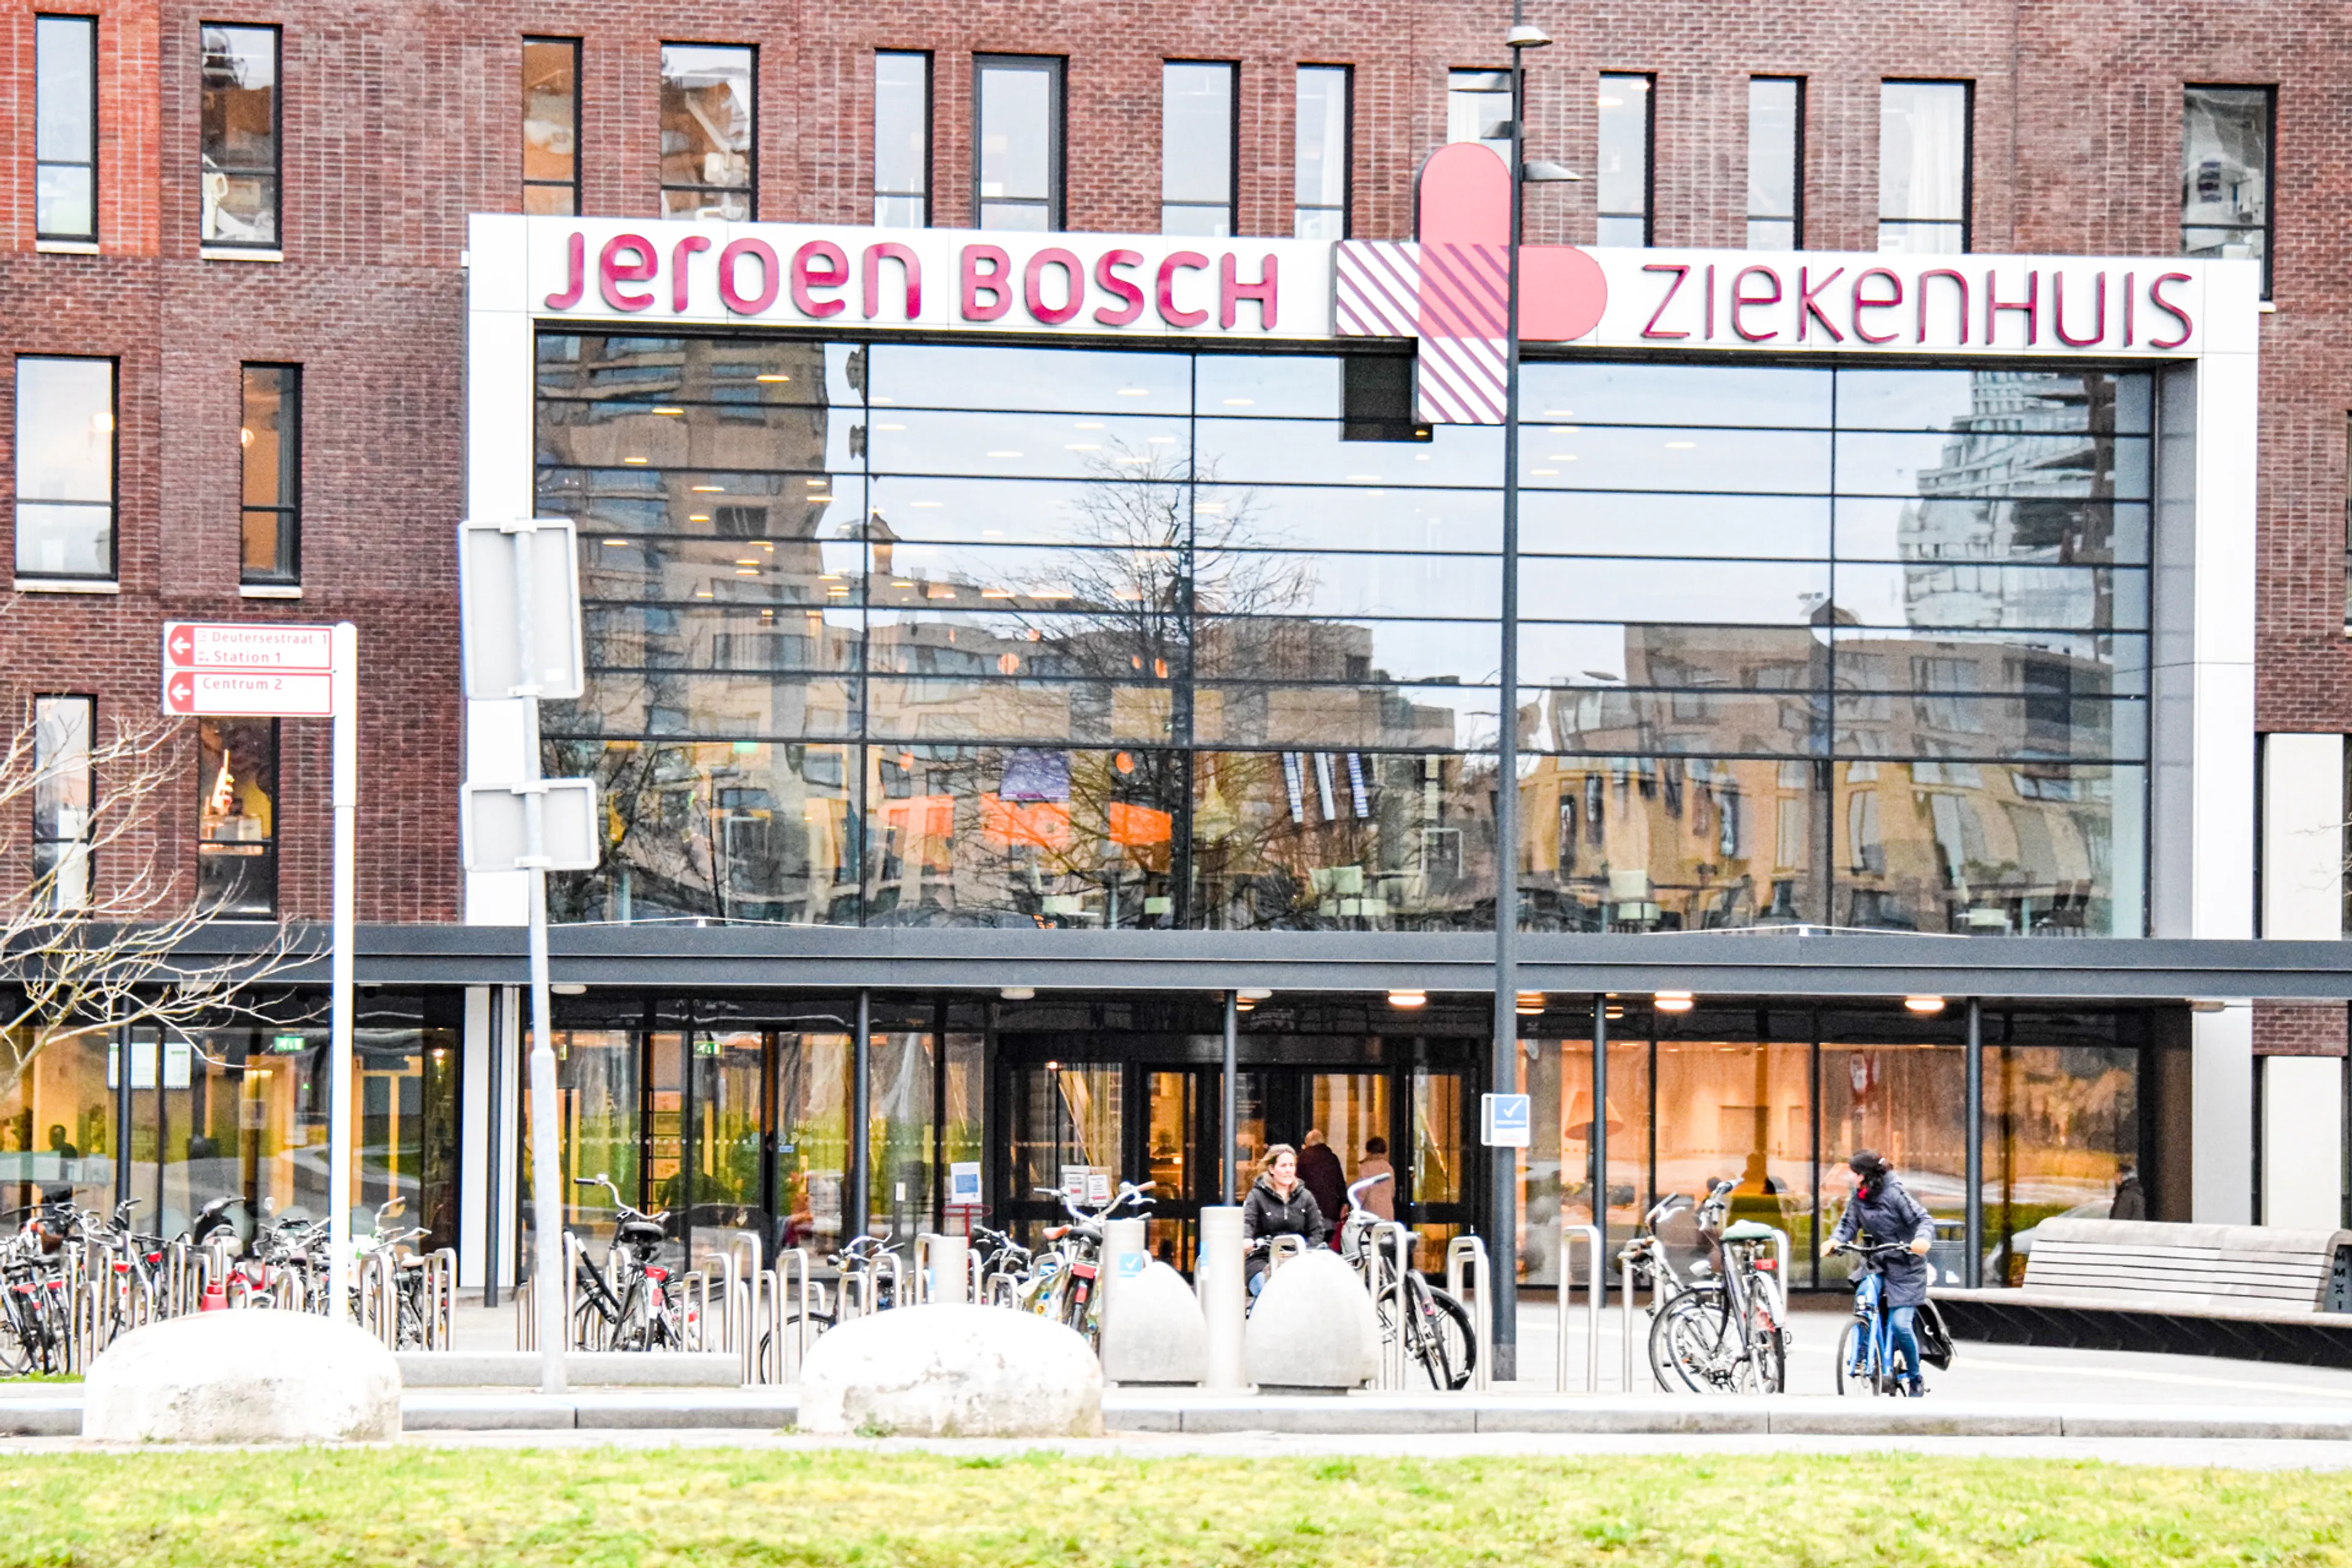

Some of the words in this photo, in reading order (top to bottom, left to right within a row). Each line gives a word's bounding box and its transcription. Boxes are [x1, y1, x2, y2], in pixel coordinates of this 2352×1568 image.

[961, 243, 1278, 331] BOSCH
[213, 631, 314, 644] Deutersestraat
[322, 634, 327, 644] 1
[214, 650, 270, 663] Station
[275, 652, 281, 663] 1
[203, 677, 268, 690] Centrum
[274, 678, 282, 690] 2
